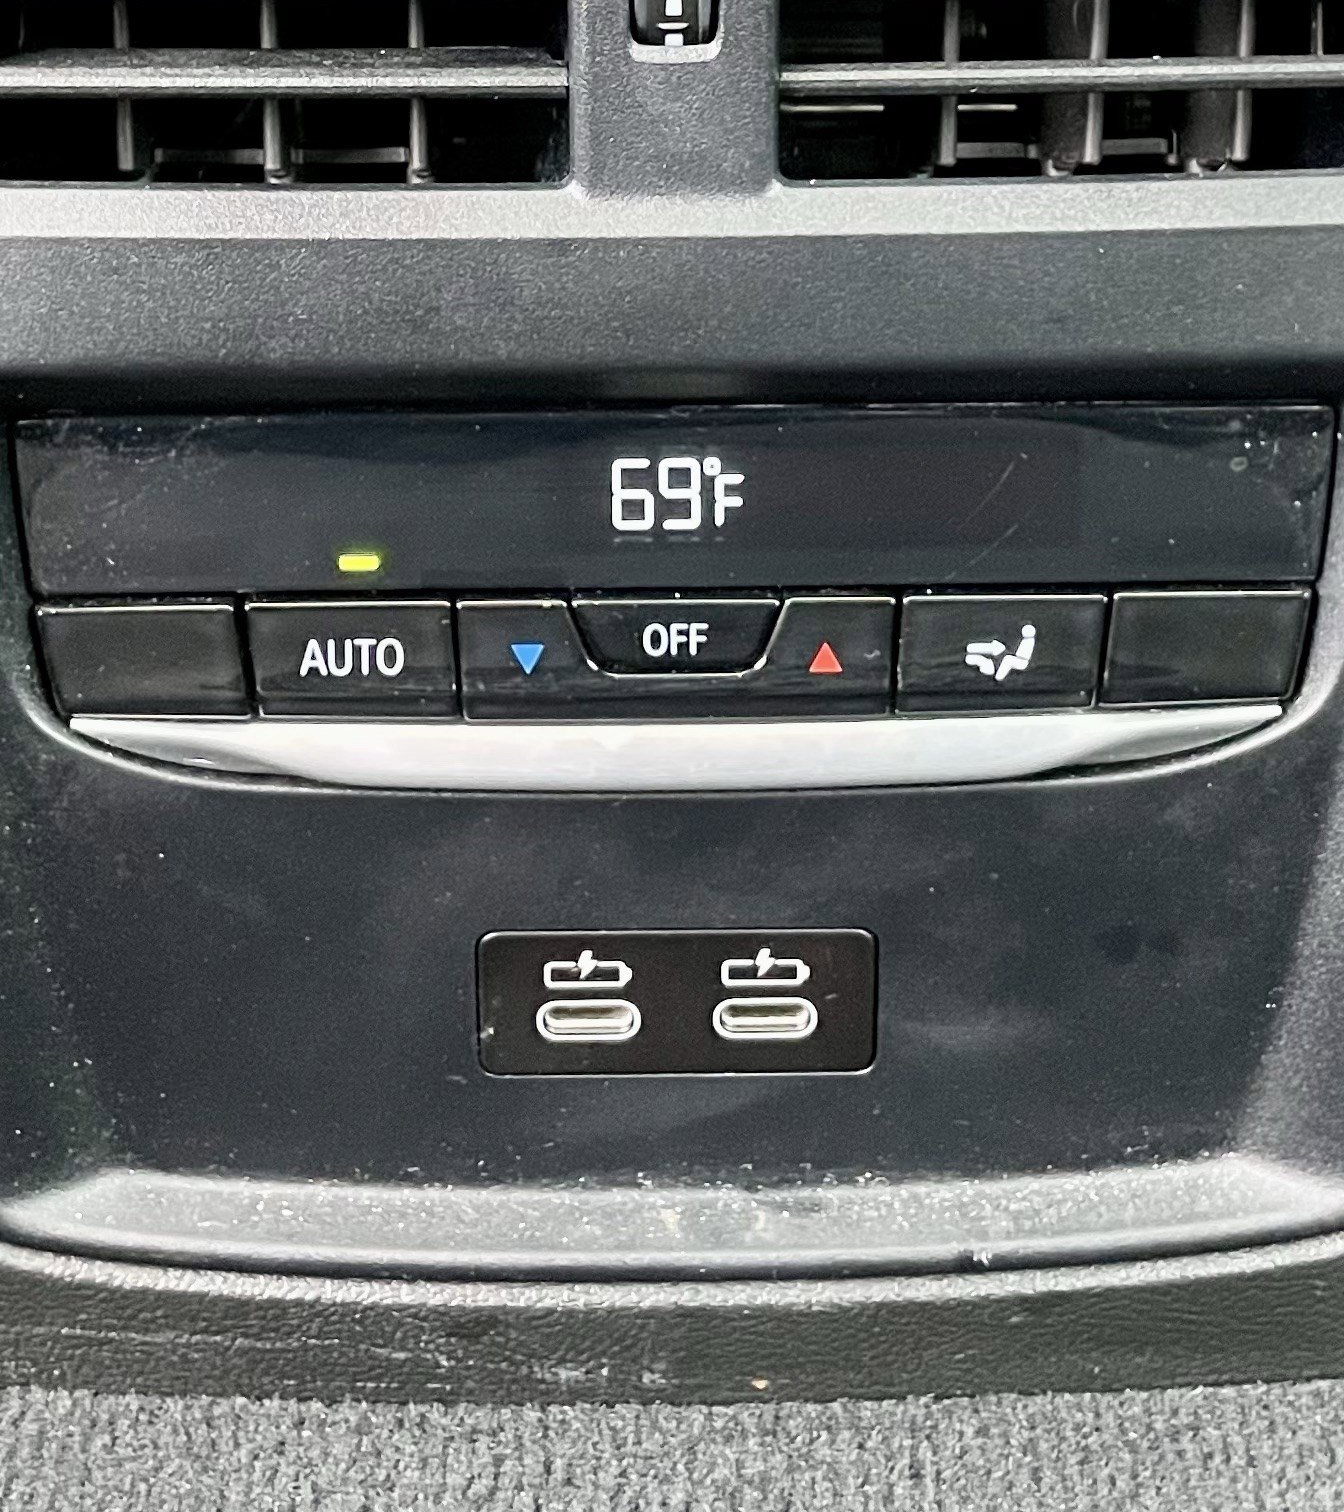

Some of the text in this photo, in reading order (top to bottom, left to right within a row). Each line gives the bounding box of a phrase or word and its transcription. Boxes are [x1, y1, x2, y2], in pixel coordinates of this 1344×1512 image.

[611, 456, 745, 531] 69°F
[299, 637, 405, 677] AUTO
[642, 622, 709, 657] OFF
